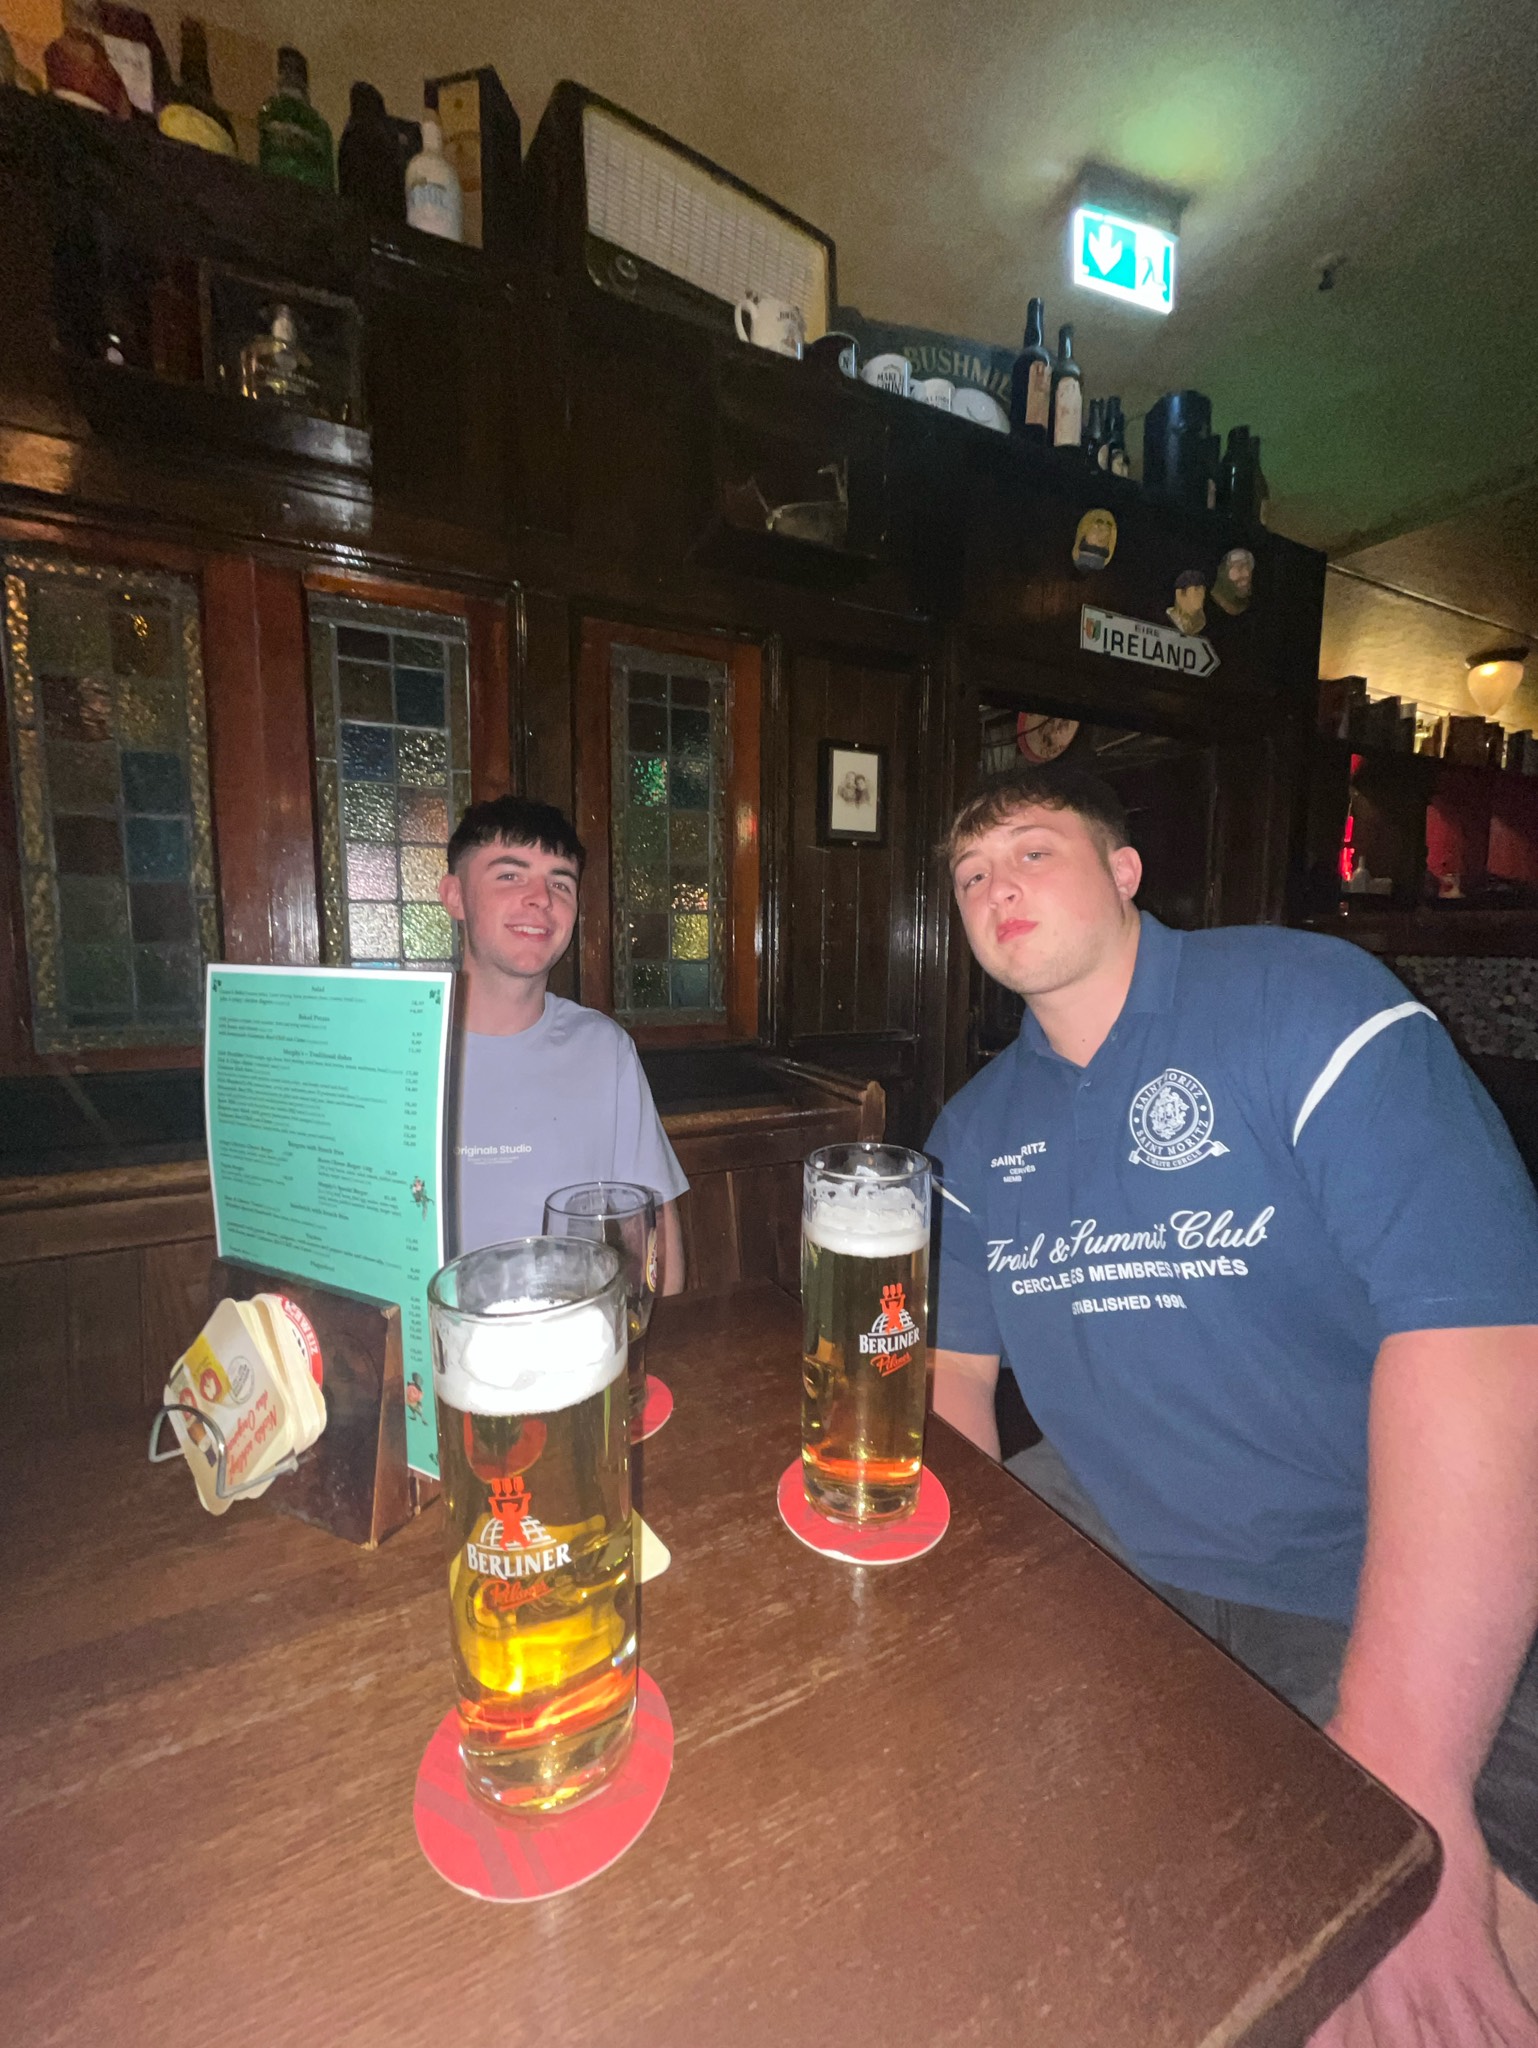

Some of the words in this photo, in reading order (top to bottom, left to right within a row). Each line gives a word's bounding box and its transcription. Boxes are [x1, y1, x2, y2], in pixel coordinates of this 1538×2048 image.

[1103, 628, 1196, 669] IRELAND
[499, 1144, 532, 1154] Studio
[1136, 1129, 1164, 1155] SAINT
[1167, 1120, 1209, 1155] MORITZ
[990, 1155, 1023, 1168] SAINT
[1172, 1149, 1203, 1167] CERCLE
[987, 1232, 1045, 1272] Trail
[1049, 1237, 1070, 1264] &
[1069, 1218, 1167, 1258] Summit
[1170, 1205, 1275, 1250] Club
[1011, 1272, 1072, 1295] CERCLE
[1089, 1261, 1174, 1283] MEMBRES
[1173, 1255, 1249, 1280] PRIVÉS
[858, 1327, 920, 1355] BERLINER
[225, 1409, 256, 1451] Origina
[466, 1542, 573, 1580] BERLINER
